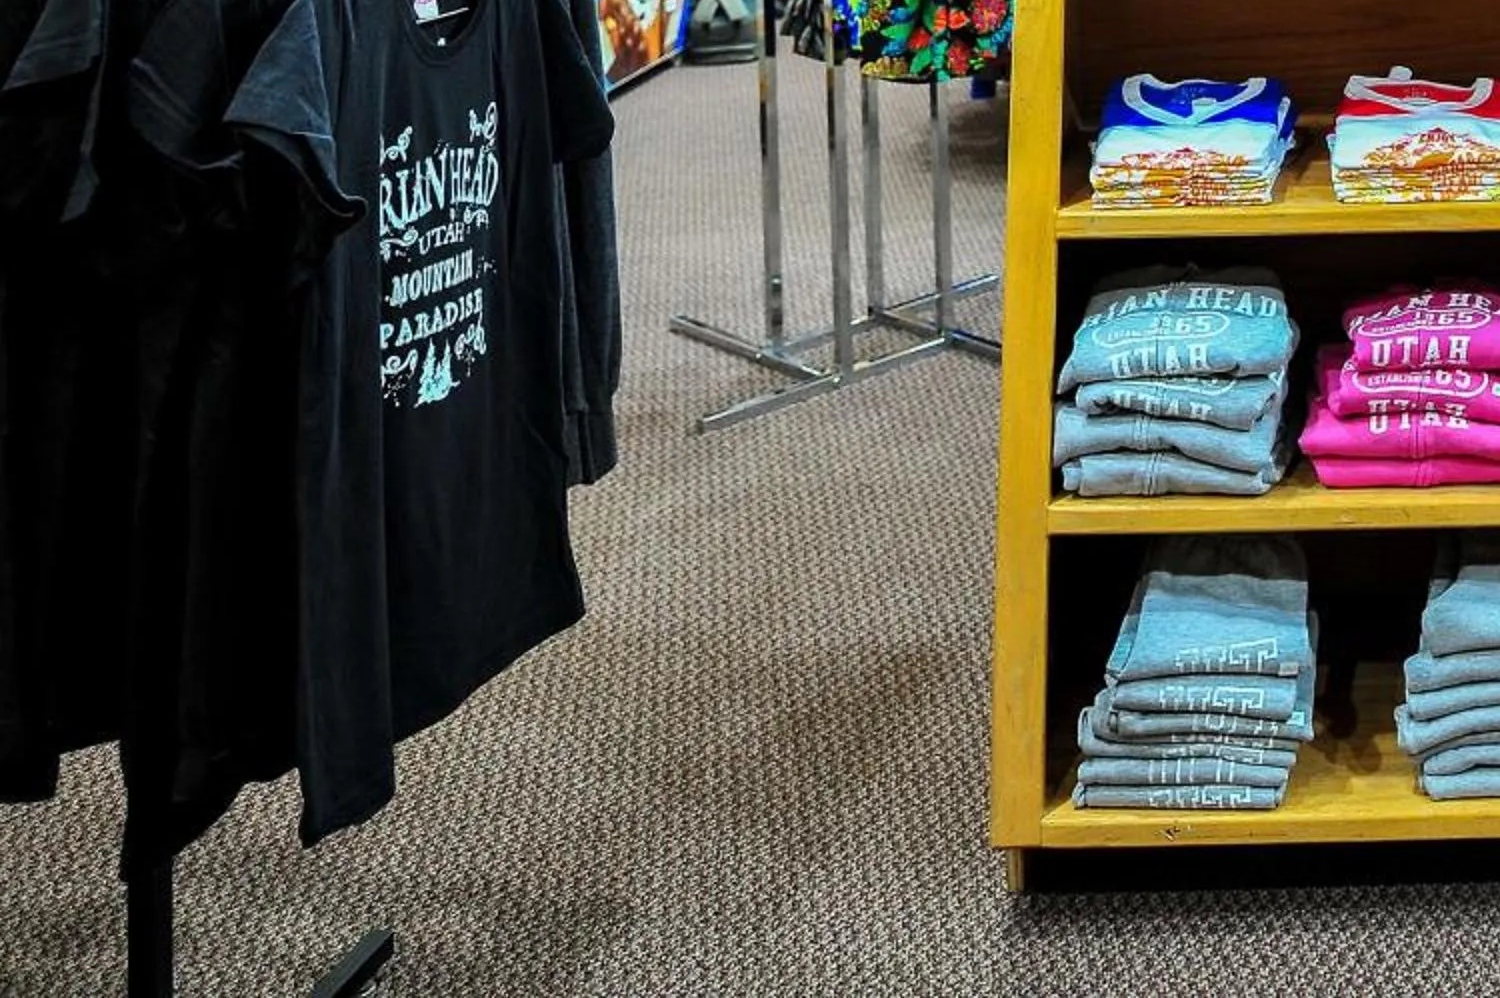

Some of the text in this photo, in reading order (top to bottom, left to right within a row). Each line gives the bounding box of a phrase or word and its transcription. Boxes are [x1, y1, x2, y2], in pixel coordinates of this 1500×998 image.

[379, 146, 499, 236] RIAN HEAD
[418, 221, 465, 255] UTAH
[389, 249, 474, 307] MOUNTAIN
[379, 288, 484, 349] PARADISE
[1185, 287, 1278, 318] HEAD
[1109, 343, 1211, 378] UTAH
[1371, 335, 1473, 368] UTAH
